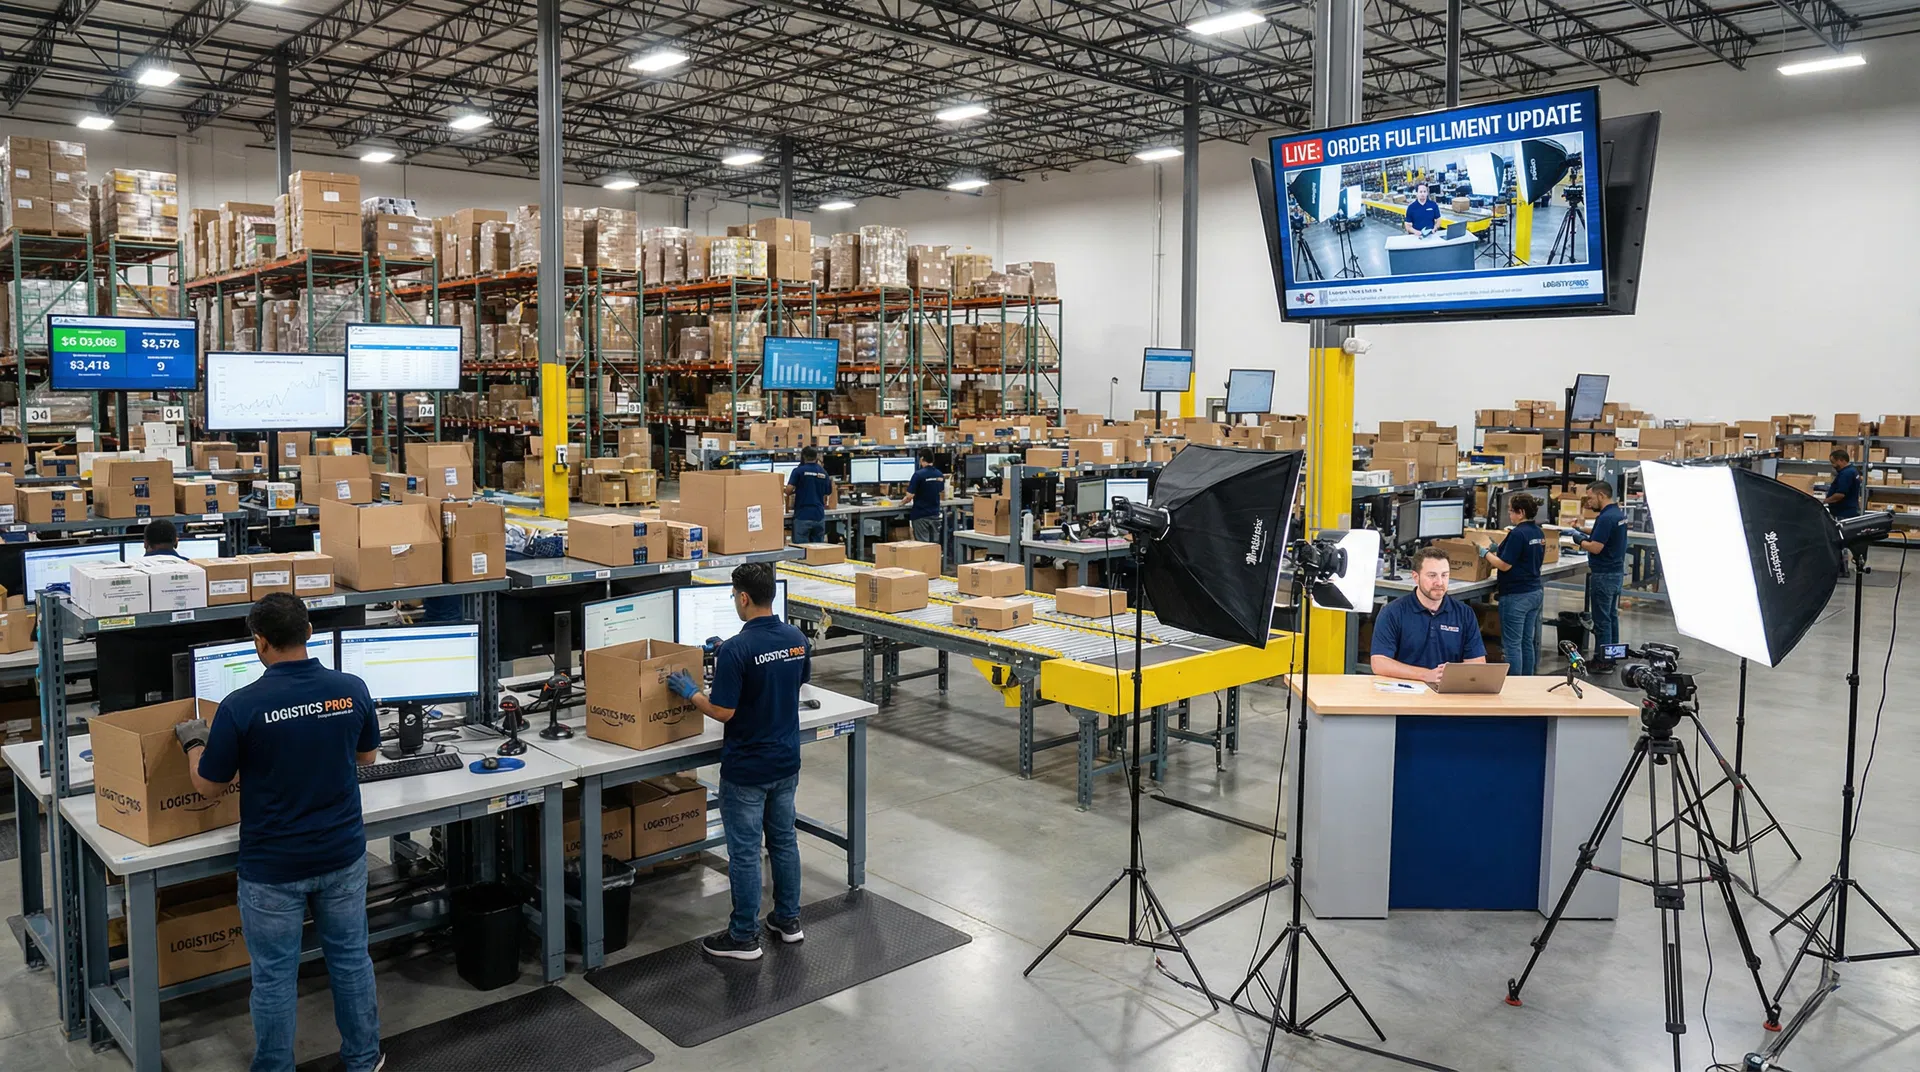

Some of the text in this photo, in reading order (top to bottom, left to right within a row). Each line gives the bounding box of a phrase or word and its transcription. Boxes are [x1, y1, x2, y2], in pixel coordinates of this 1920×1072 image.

[1285, 103, 1582, 164] LIVE: ORDER FULFILLMENT UPDATE
[141, 338, 180, 349] $2,578
[264, 701, 323, 723] LOGISTICS
[324, 697, 353, 712] PROS
[170, 926, 243, 953] LOGISTICS PR
